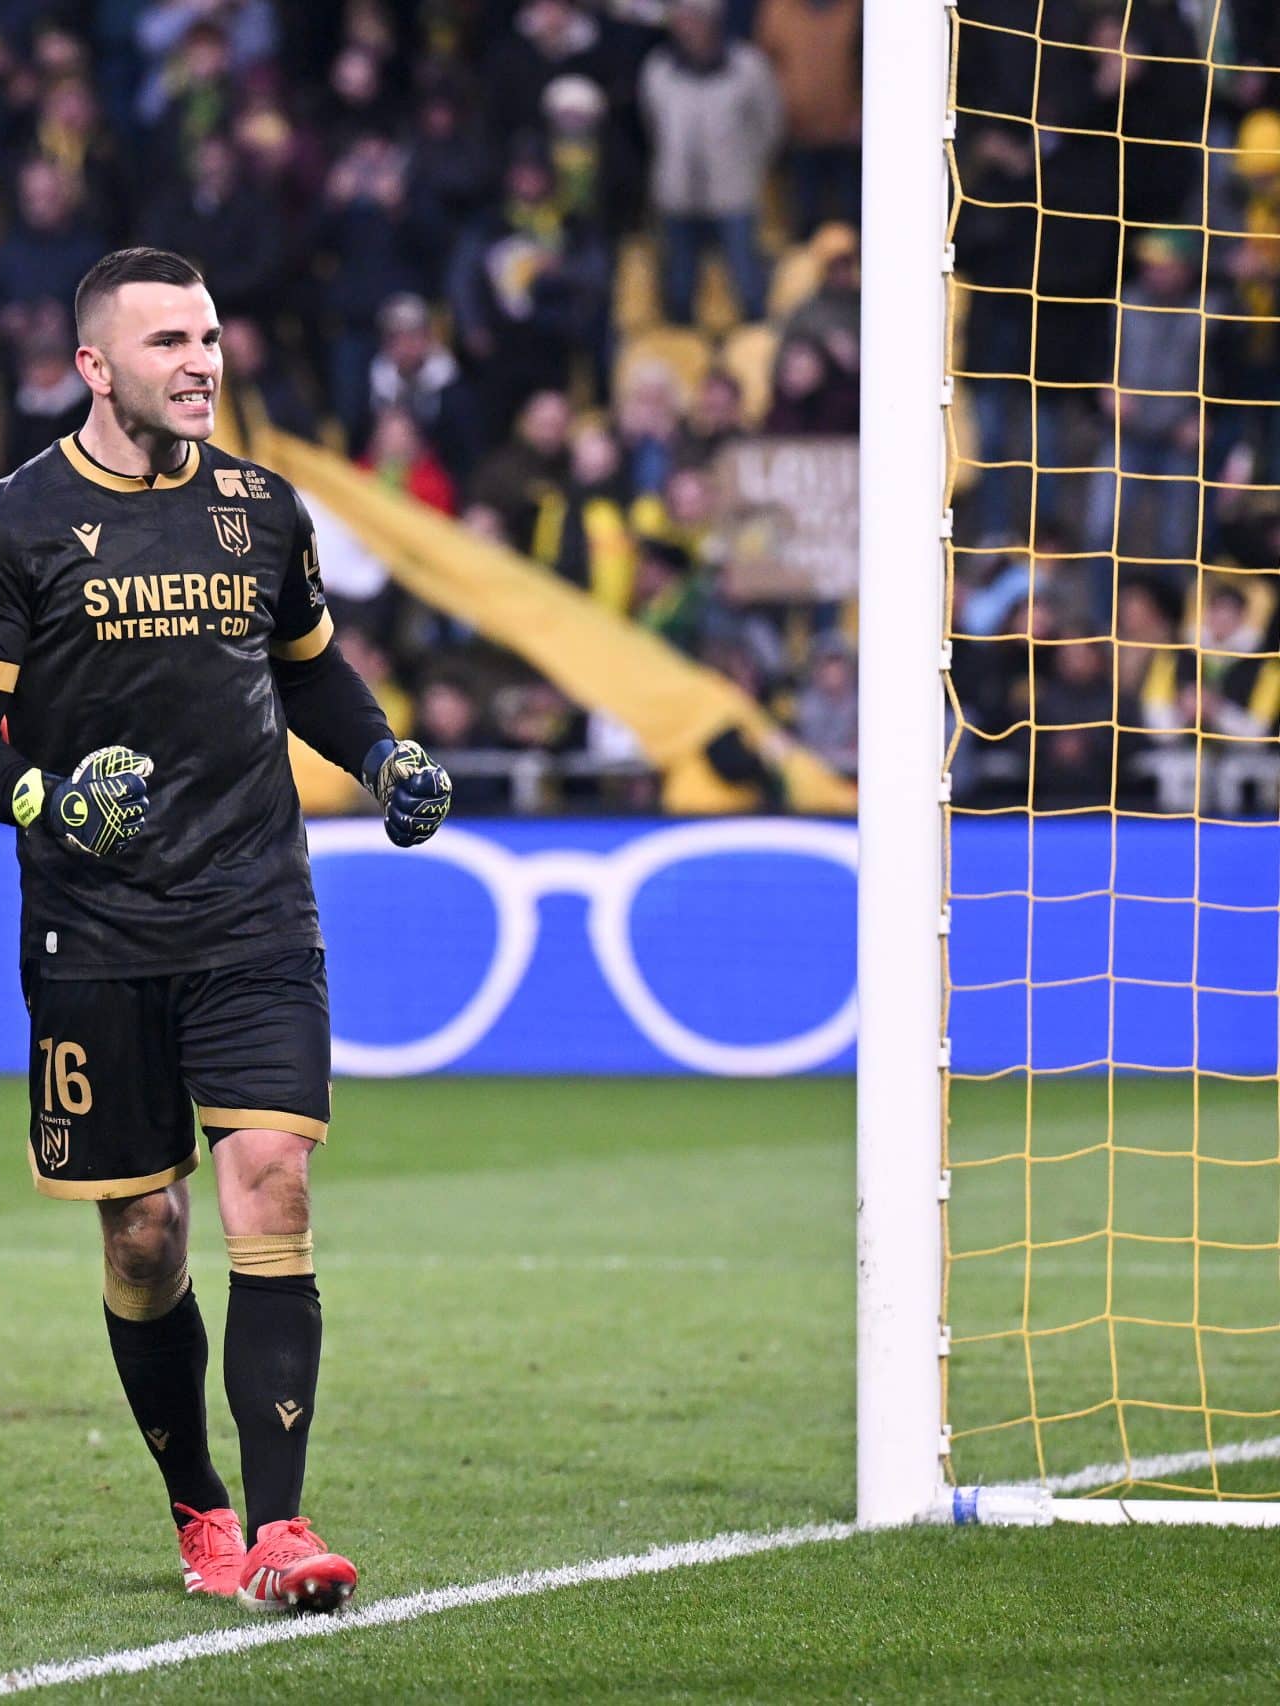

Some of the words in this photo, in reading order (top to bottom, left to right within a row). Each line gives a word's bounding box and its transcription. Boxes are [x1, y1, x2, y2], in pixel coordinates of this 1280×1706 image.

[83, 572, 257, 617] SYNERGIE
[96, 616, 200, 641] INTERIM
[220, 617, 249, 637] CDI
[38, 1036, 93, 1116] 16
